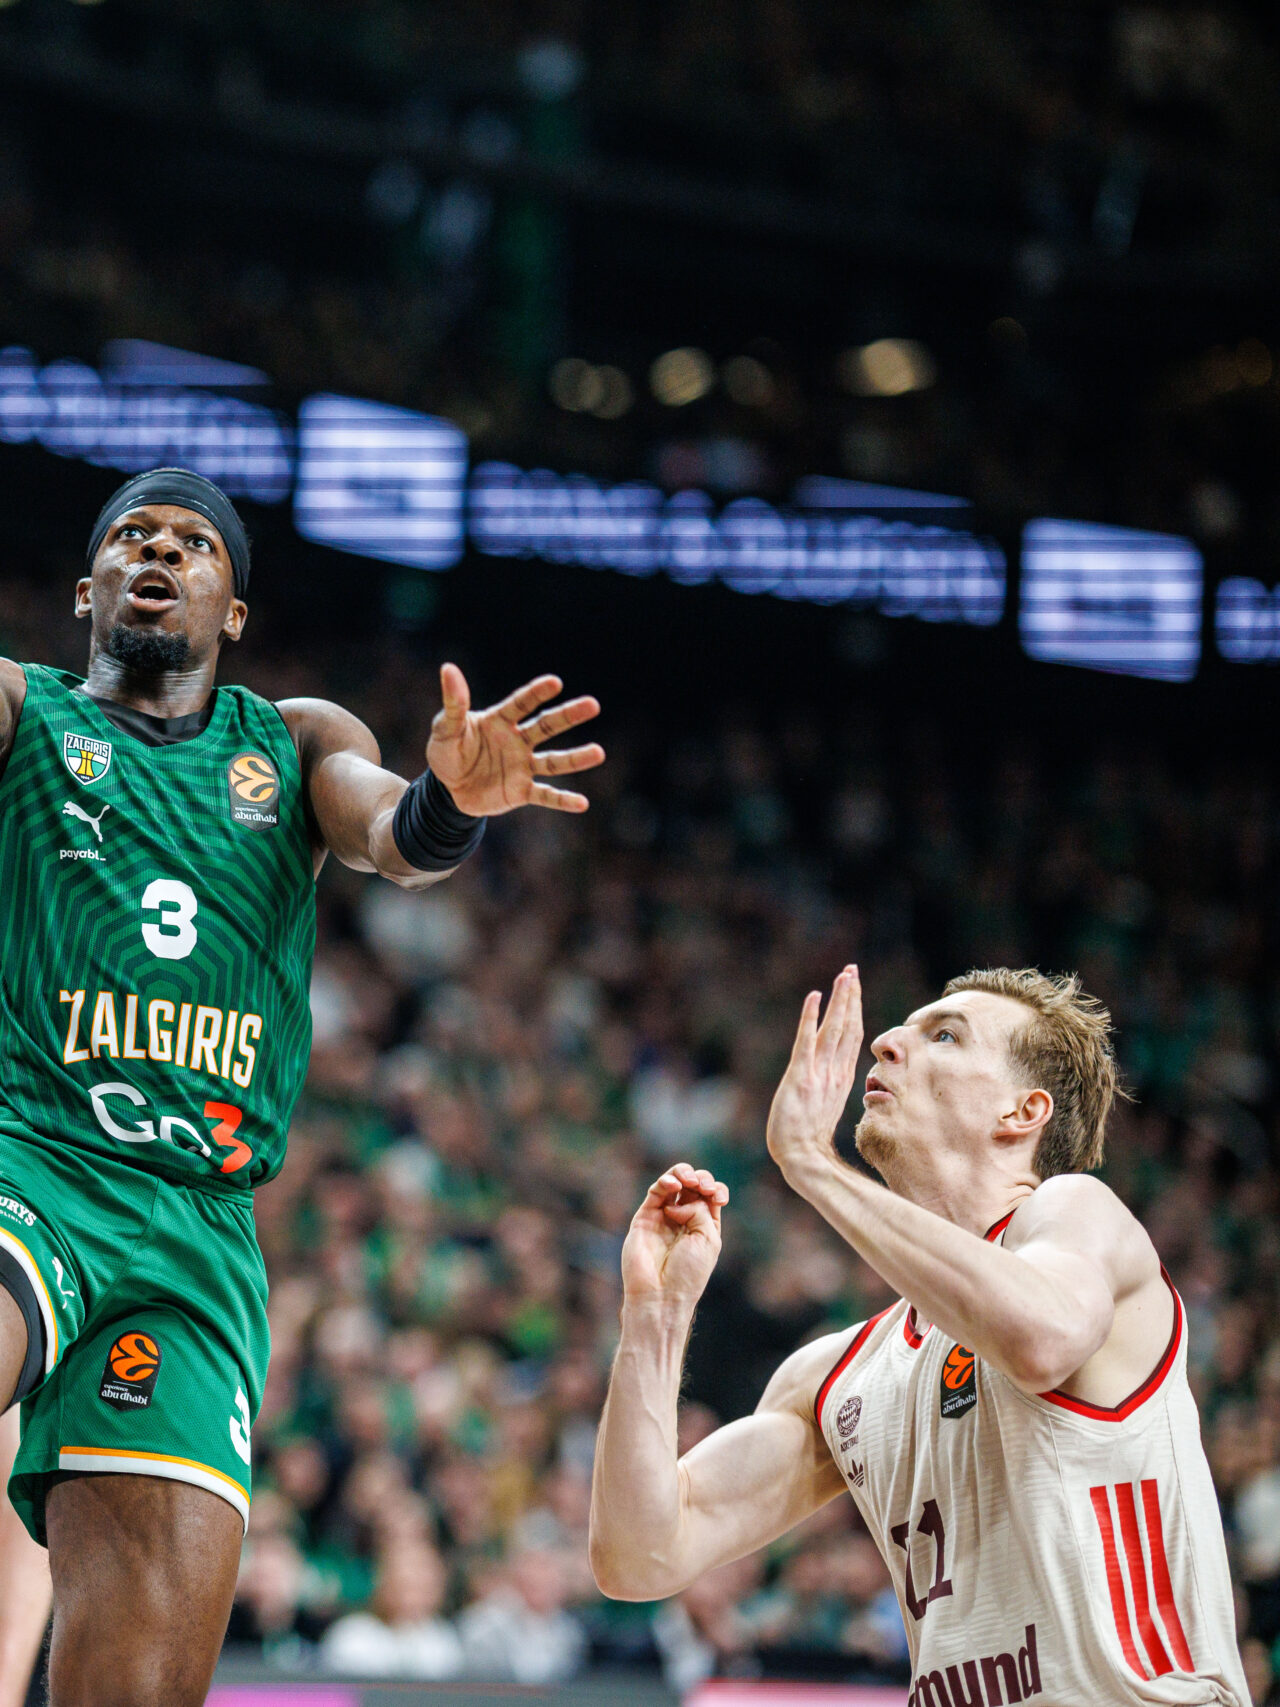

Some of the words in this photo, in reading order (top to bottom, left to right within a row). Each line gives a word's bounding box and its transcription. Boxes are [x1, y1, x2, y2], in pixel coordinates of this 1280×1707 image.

[235, 811, 251, 820] abu
[253, 813, 277, 823] dhabi
[141, 878, 197, 960] 3
[101, 1390, 119, 1399] abu
[120, 1392, 148, 1405] dhabi
